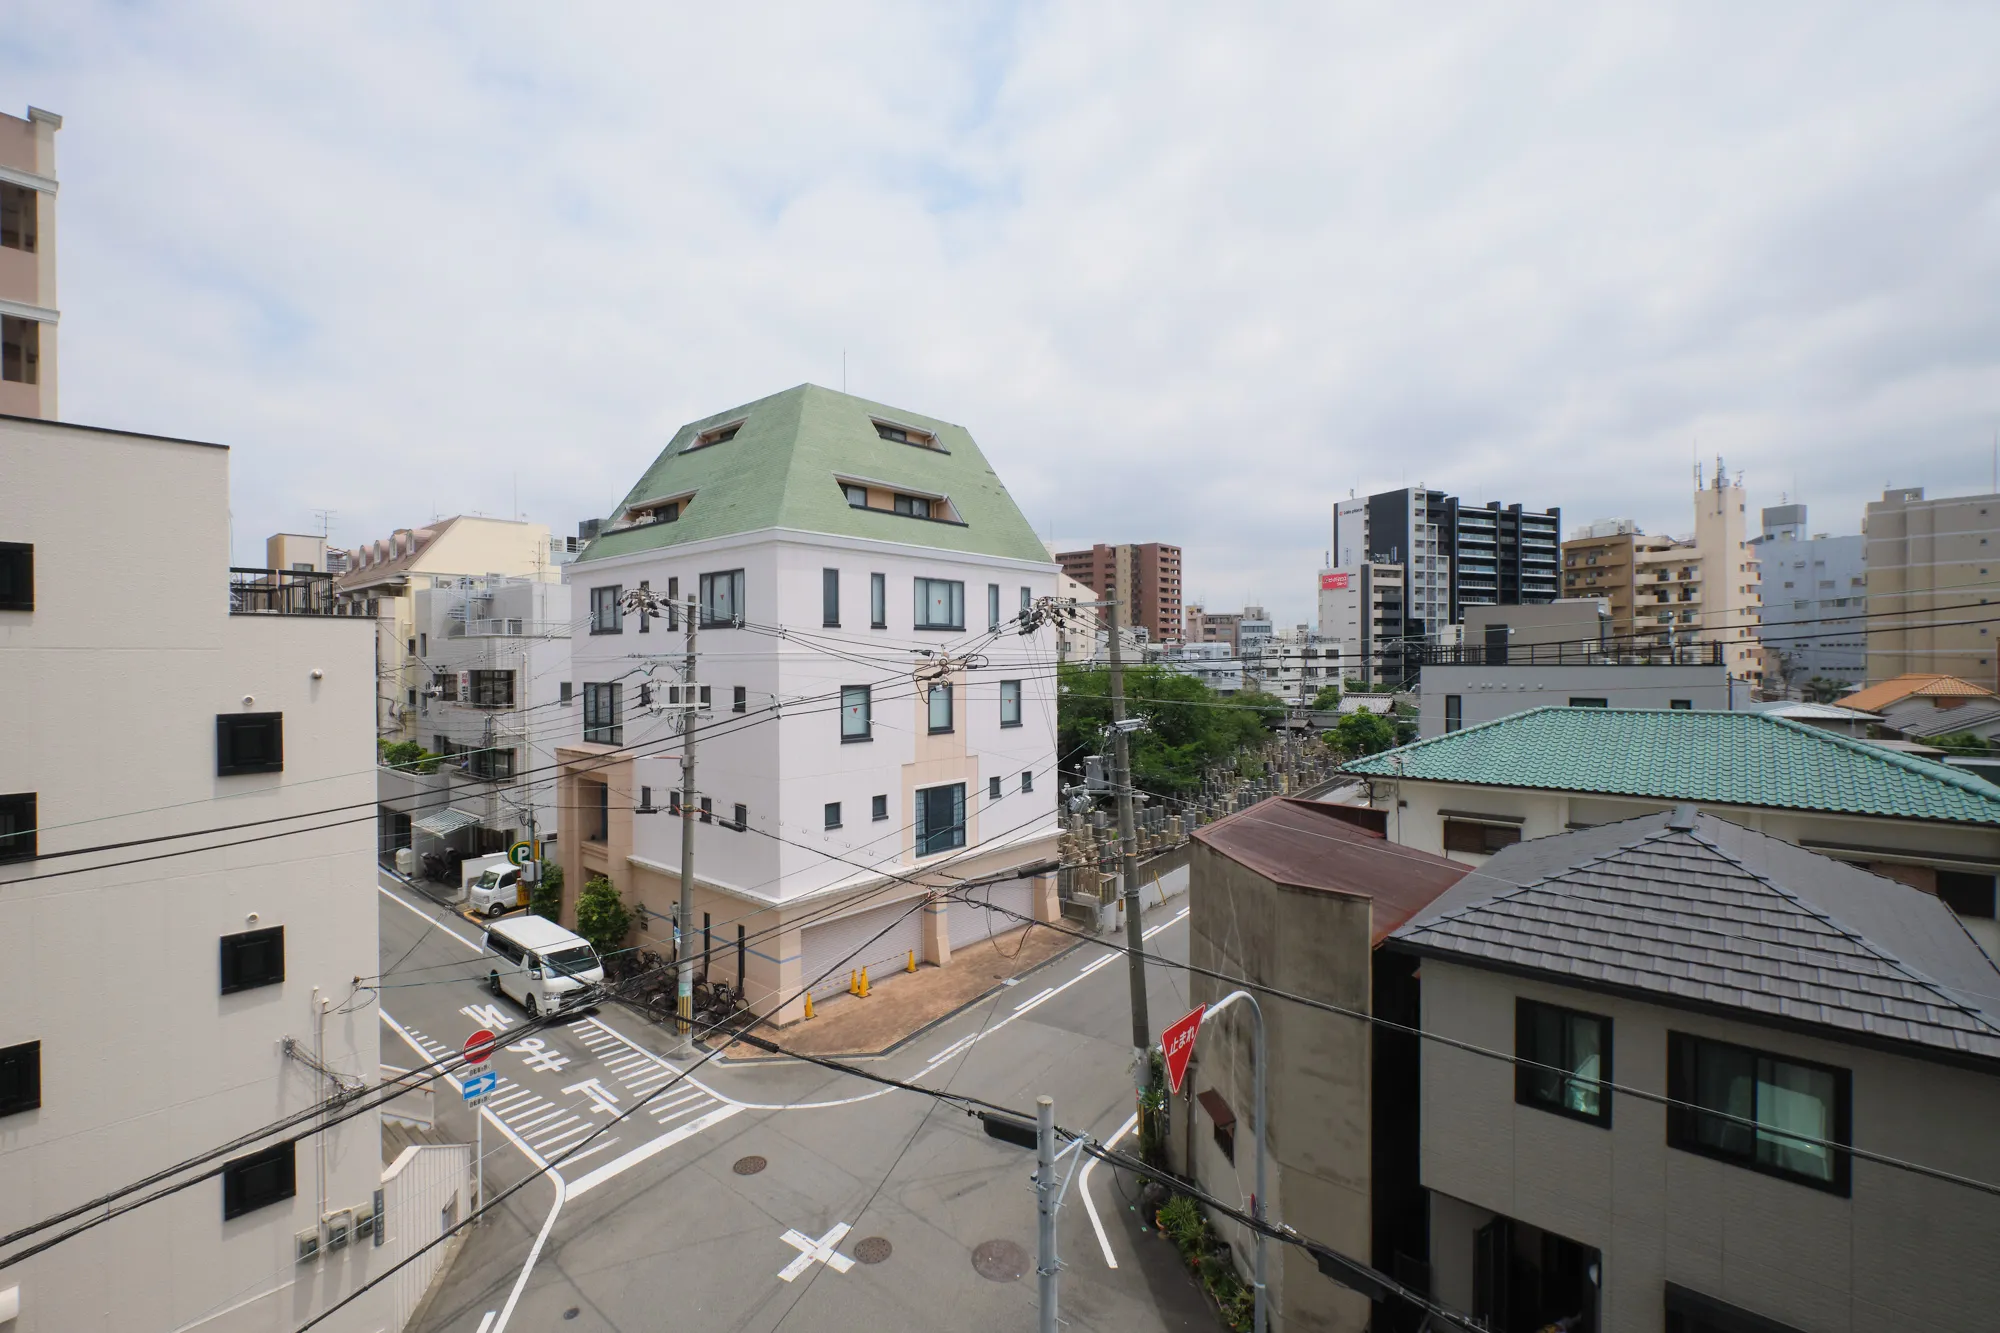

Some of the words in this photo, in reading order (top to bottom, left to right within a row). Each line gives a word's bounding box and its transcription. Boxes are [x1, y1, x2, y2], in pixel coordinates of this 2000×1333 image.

[517, 846, 530, 862] P
[1168, 1025, 1195, 1057] 止まれ
